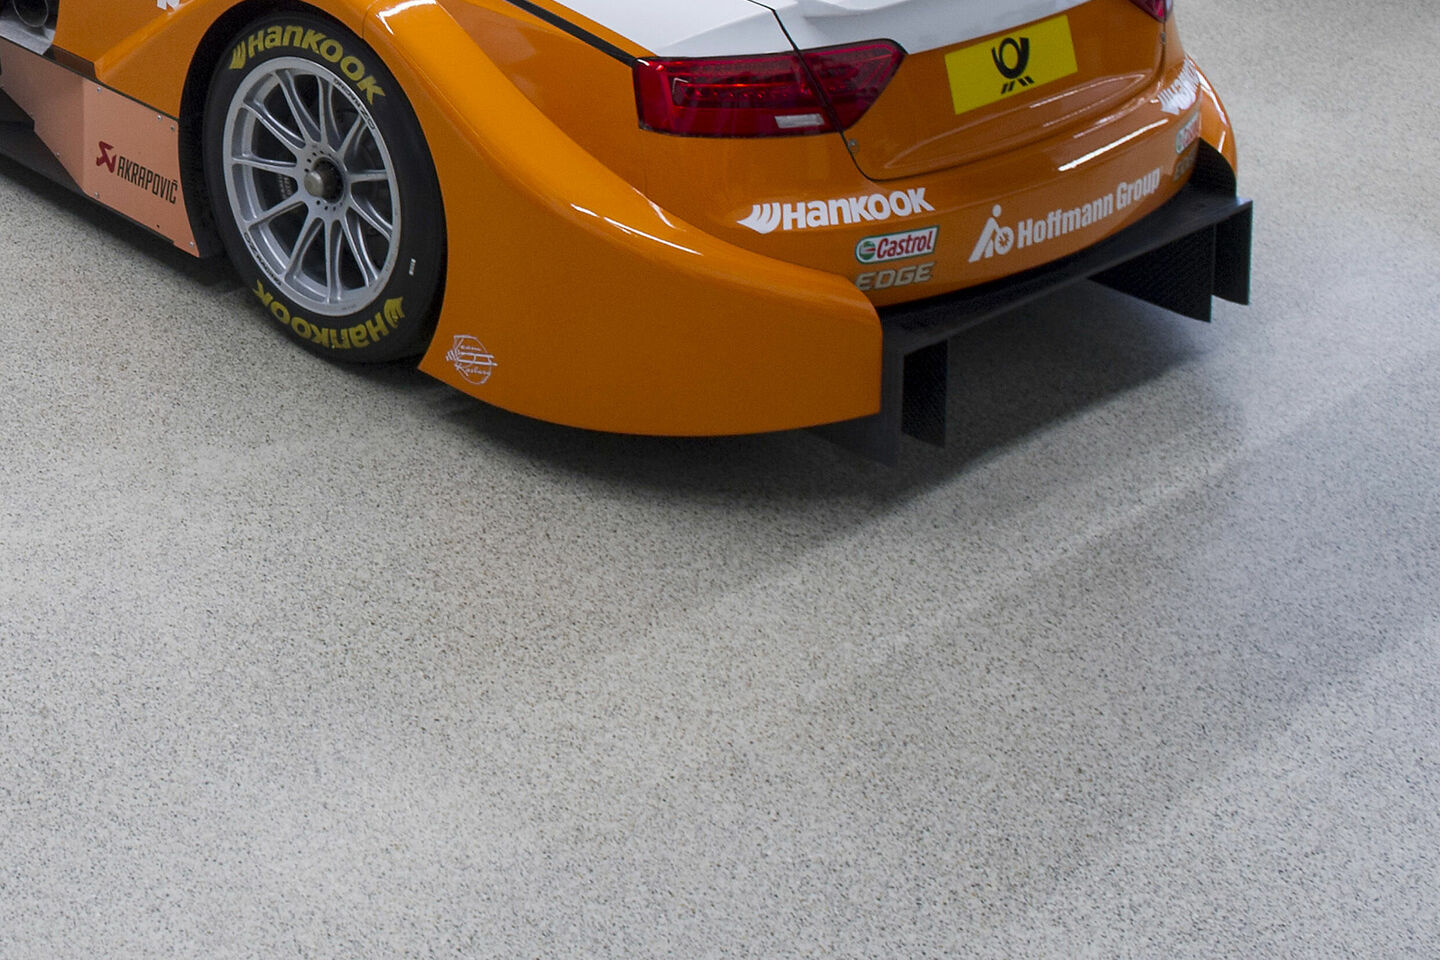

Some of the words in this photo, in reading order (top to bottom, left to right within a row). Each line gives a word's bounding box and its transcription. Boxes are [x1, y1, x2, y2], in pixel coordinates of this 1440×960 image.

[116, 155, 178, 205] AKRAPOVIČ
[1016, 193, 1114, 249] Hoffmann
[1116, 167, 1160, 211] Group
[876, 229, 933, 259] Castrol
[855, 262, 935, 291] EDGE
